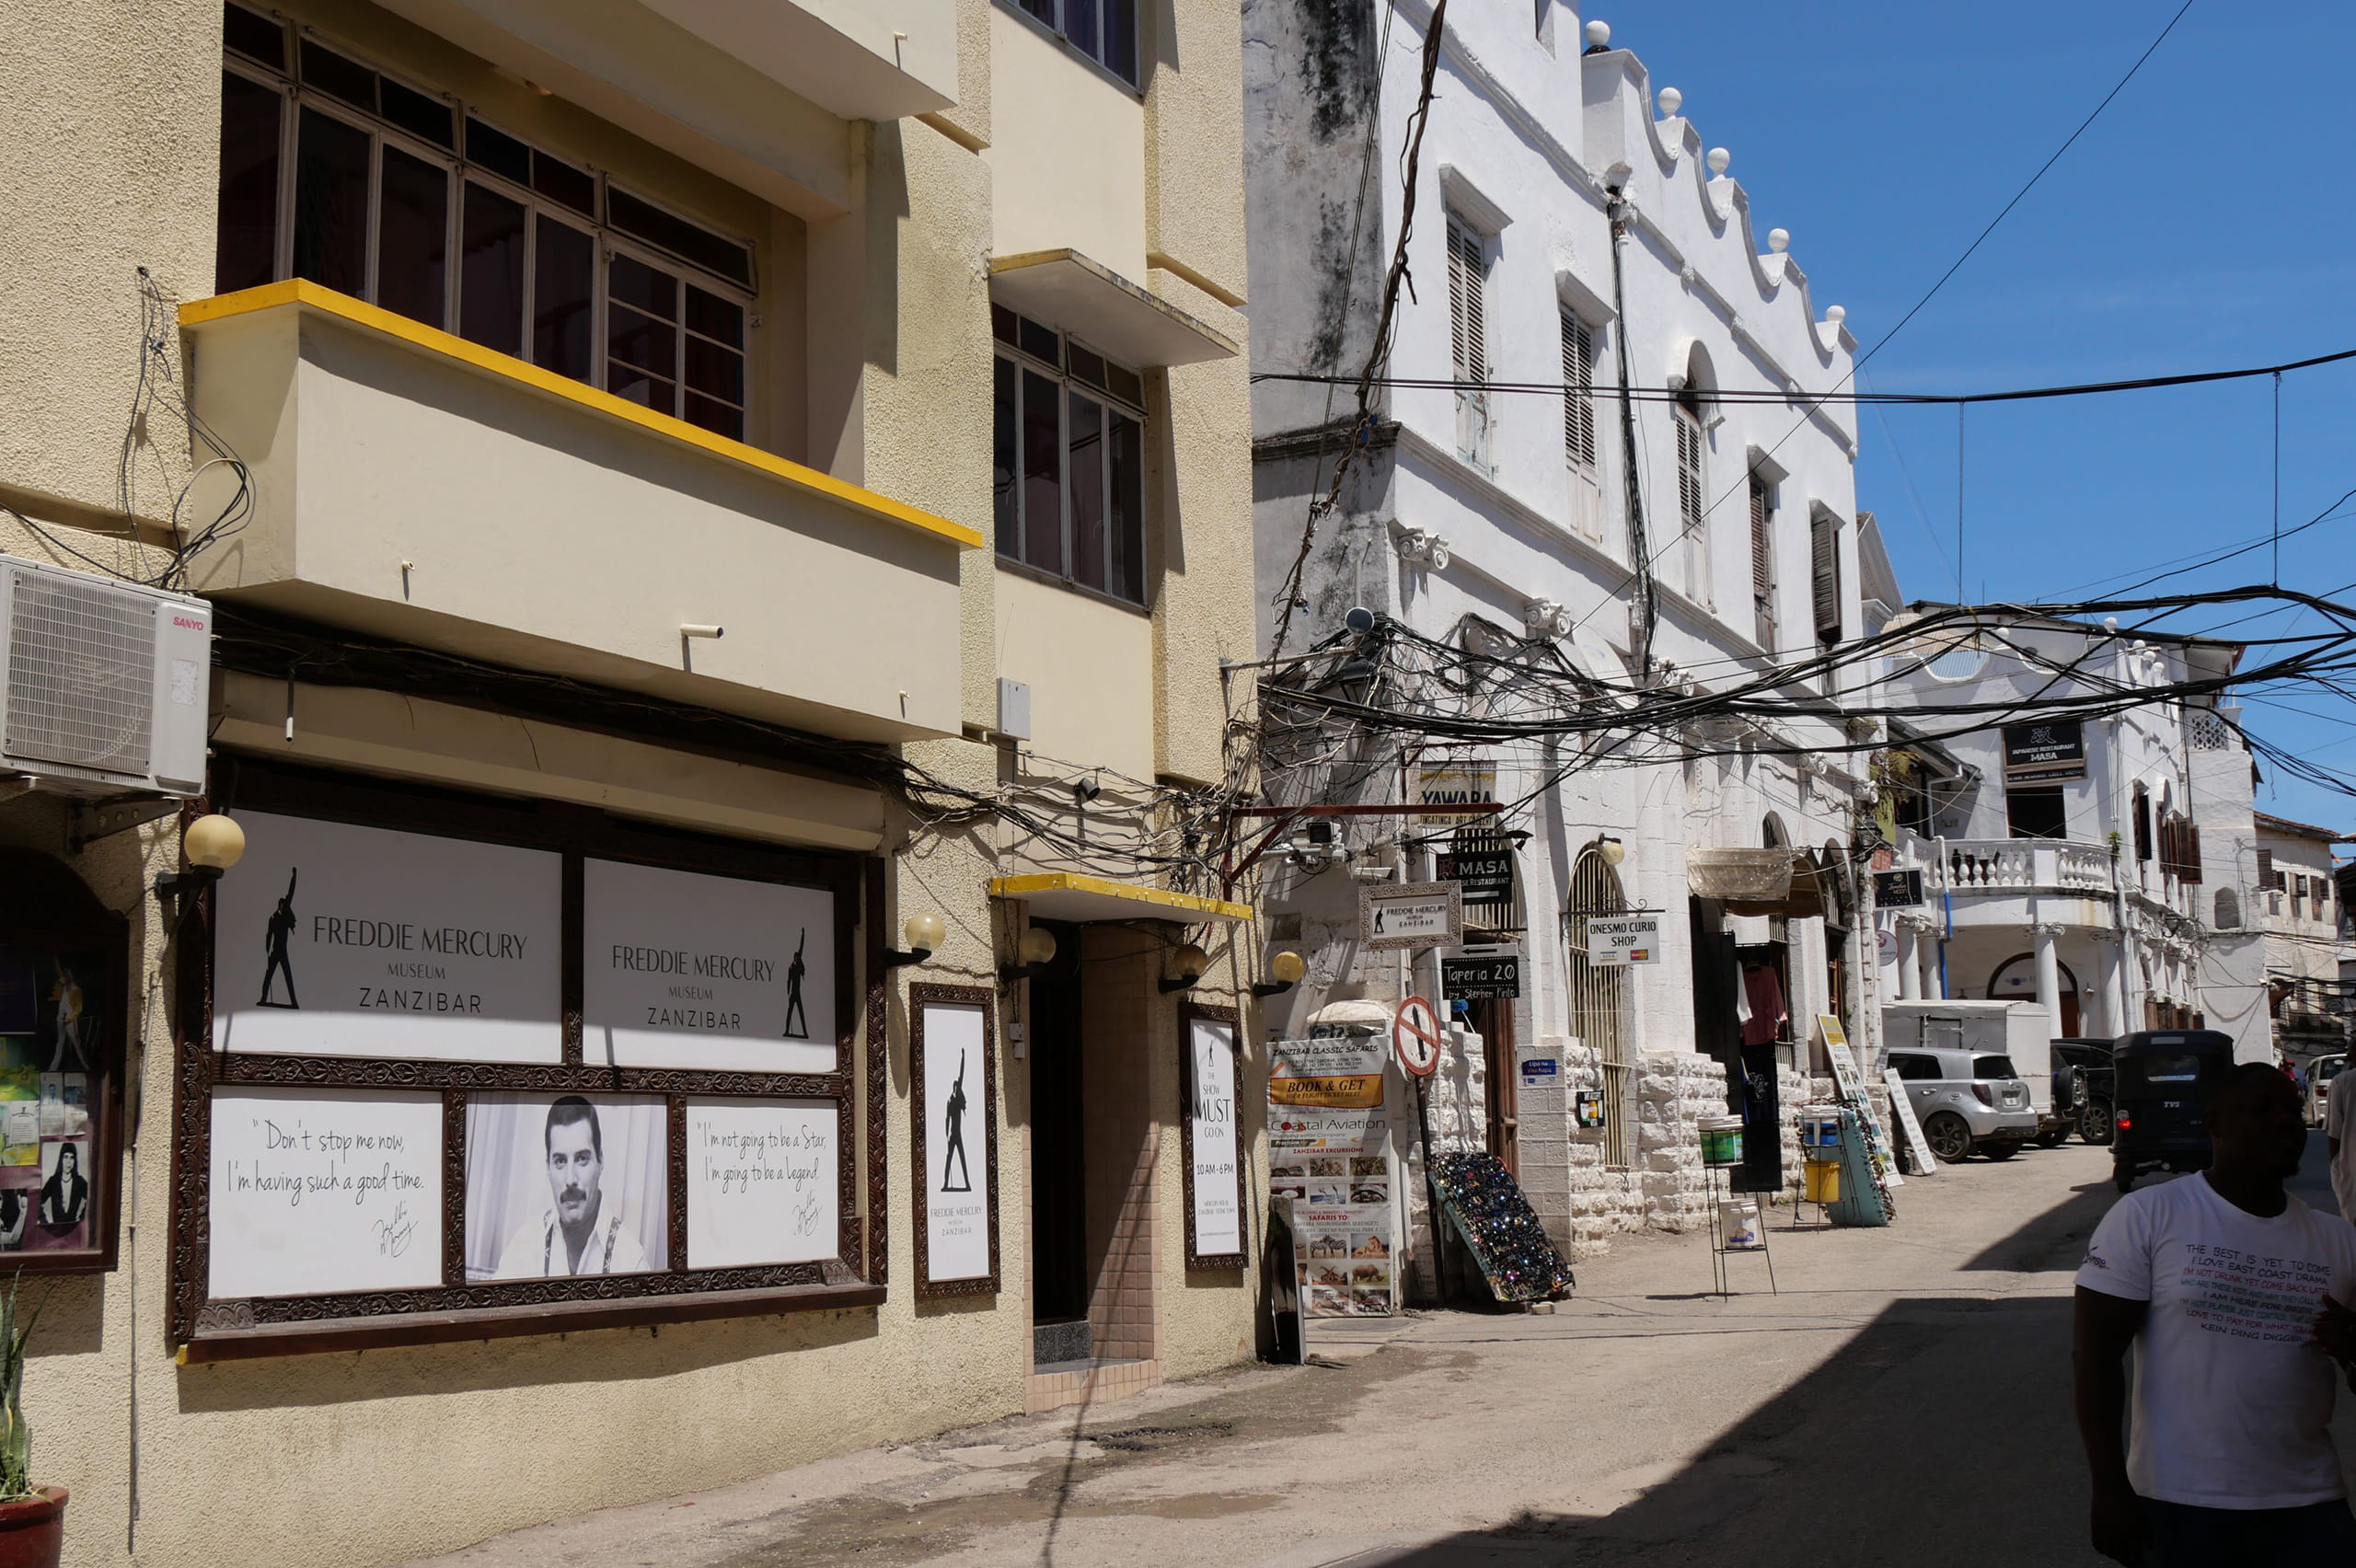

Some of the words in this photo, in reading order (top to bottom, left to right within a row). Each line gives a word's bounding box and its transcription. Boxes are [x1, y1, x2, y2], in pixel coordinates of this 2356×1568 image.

[173, 617, 203, 631] SANYO
[2039, 744, 2075, 752] RESTAURANT
[2030, 752, 2058, 762] MASA
[1420, 814, 1451, 825] TINGATINGA
[1456, 814, 1466, 824] ART
[1459, 859, 1509, 875] MASA
[1470, 877, 1509, 886] RESTAURANT
[1387, 907, 1415, 916] FREDDIE
[1415, 905, 1447, 915] MERCURY
[1589, 923, 1627, 935] ONESMO
[1629, 921, 1657, 932] CURIO
[314, 916, 414, 951] FREDDIE
[422, 928, 528, 960] MERCURY
[1611, 936, 1637, 947] SHOP
[613, 945, 688, 975] FREDDIE
[693, 954, 775, 982] MERCURY
[387, 963, 445, 980] MUSEUM
[1443, 966, 1487, 985] Taperia
[1494, 964, 1515, 980] 2.0
[359, 987, 481, 1013] ZANZIBAR
[669, 986, 713, 1000] MUSEUM
[1449, 991, 1460, 1000] by
[1465, 988, 1494, 999] Stephen
[647, 1008, 741, 1030] ZANZIBAR
[1273, 1046, 1311, 1056] ZANZIBAR
[1312, 1046, 1343, 1055] CLASSIC
[1346, 1044, 1379, 1053] SAFARIS
[1203, 1085, 1220, 1096] SHOW
[1288, 1080, 1322, 1093] BOOK
[1325, 1080, 1334, 1091] &
[1339, 1078, 1366, 1090] GET
[1195, 1098, 1231, 1123] MUST
[1205, 1126, 1214, 1137] GO
[1215, 1127, 1224, 1136] ON
[1326, 1118, 1386, 1131] Aviation
[318, 1130, 352, 1163] stop
[356, 1135, 375, 1149] me
[378, 1135, 405, 1153] now,
[722, 1130, 738, 1147] not
[739, 1131, 766, 1159] going
[768, 1131, 779, 1147] to
[780, 1124, 791, 1147] be
[792, 1137, 800, 1147] a
[802, 1124, 826, 1149] Star,
[705, 1156, 721, 1181] I'm
[722, 1165, 748, 1193] going
[751, 1164, 762, 1181] to
[764, 1158, 775, 1180] be
[777, 1169, 783, 1180] a
[1197, 1165, 1204, 1175] 10
[1206, 1164, 1216, 1174] AM
[1219, 1164, 1223, 1174] 6
[1224, 1163, 1234, 1173] PM
[228, 1160, 250, 1192] I'm
[256, 1159, 303, 1206] having
[306, 1159, 339, 1193] such
[343, 1179, 352, 1190] a
[357, 1162, 390, 1205] good
[392, 1170, 424, 1191] time.
[930, 1207, 955, 1218] FREDDIE
[957, 1205, 983, 1216] MERCURY
[942, 1227, 972, 1237] ZANZIBAR
[2187, 1244, 2207, 1254] THE
[2213, 1247, 2241, 1260] BEST
[2246, 1254, 2256, 1264] IS
[2262, 1257, 2284, 1268] YET
[2290, 1260, 2304, 1271] TO
[2306, 1262, 2331, 1276] COME
[2198, 1258, 2225, 1269] LOVE
[2227, 1262, 2256, 1274] EAST
[2258, 1268, 2293, 1279] COAST
[2295, 1274, 2328, 1286] DRAMA
[2183, 1266, 2195, 1275] I'M
[2197, 1268, 2212, 1278] NOT
[2245, 1277, 2261, 1287] YET
[2261, 1280, 2284, 1291] COME
[2286, 1283, 2308, 1294] BACK
[2209, 1293, 2227, 1301] AM
[2230, 1296, 2258, 1309] HERE
[2260, 1302, 2281, 1311] FOR
[2186, 1309, 2209, 1320] LOVE
[2212, 1313, 2224, 1322] TO
[2226, 1316, 2244, 1325] PAY
[2246, 1320, 2262, 1330] FOR
[2265, 1323, 2291, 1332] WHAT
[2200, 1322, 2228, 1333] KEIN
[2231, 1328, 2260, 1340] DING
